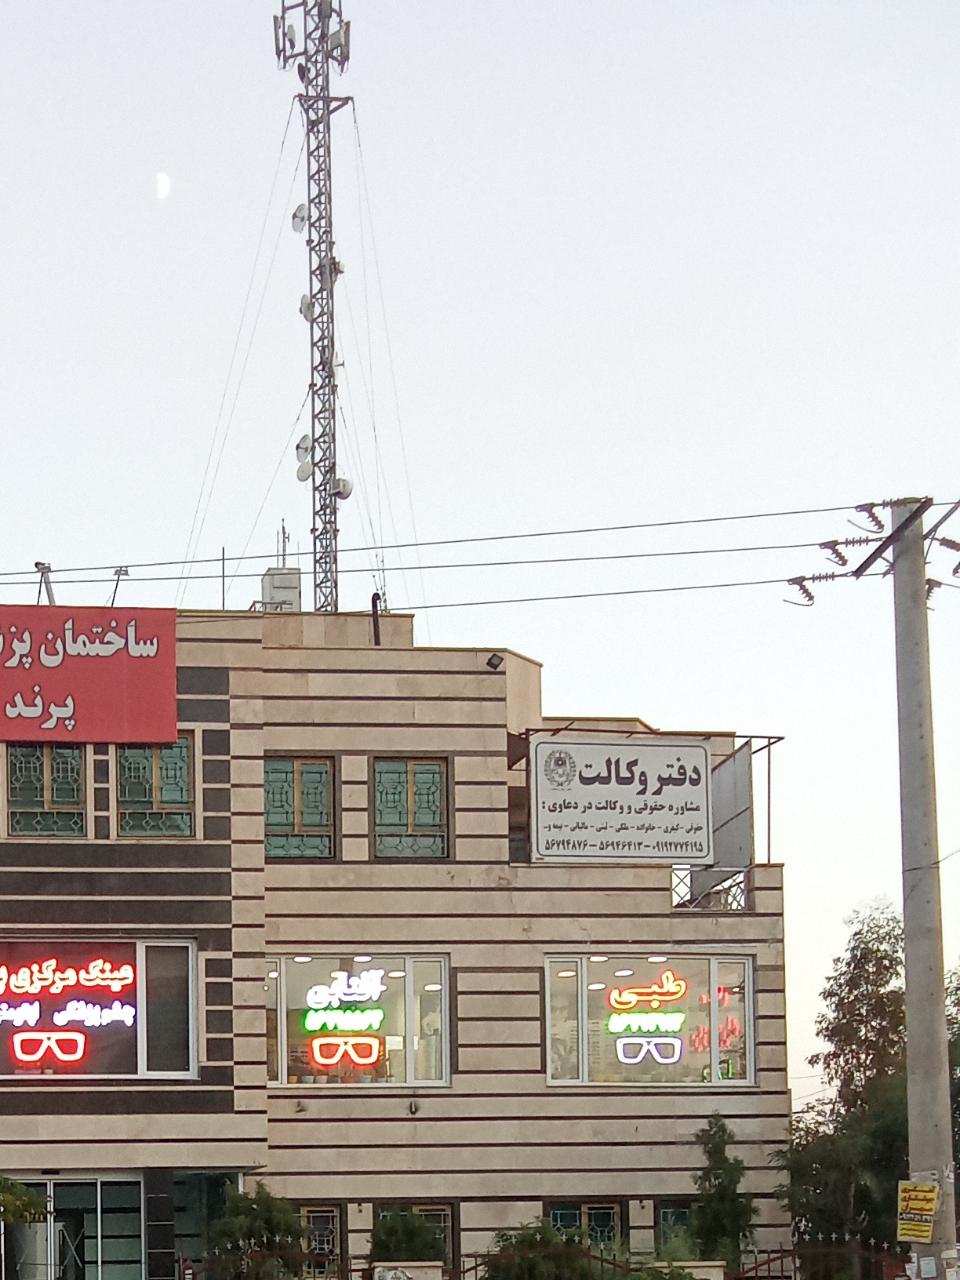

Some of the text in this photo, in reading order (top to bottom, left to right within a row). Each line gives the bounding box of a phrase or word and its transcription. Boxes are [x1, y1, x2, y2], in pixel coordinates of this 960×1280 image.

[39, 617, 158, 667] ساختمان
[5, 685, 75, 730] پرند
[579, 757, 701, 795] دفتر وکالت
[581, 802, 592, 813] در
[595, 800, 624, 814] وکالت
[627, 805, 632, 814] و
[634, 800, 666, 815] حقوقی
[668, 801, 700, 815] مشاوره
[10, 959, 77, 993] مرکزی
[610, 970, 686, 1009] طبی
